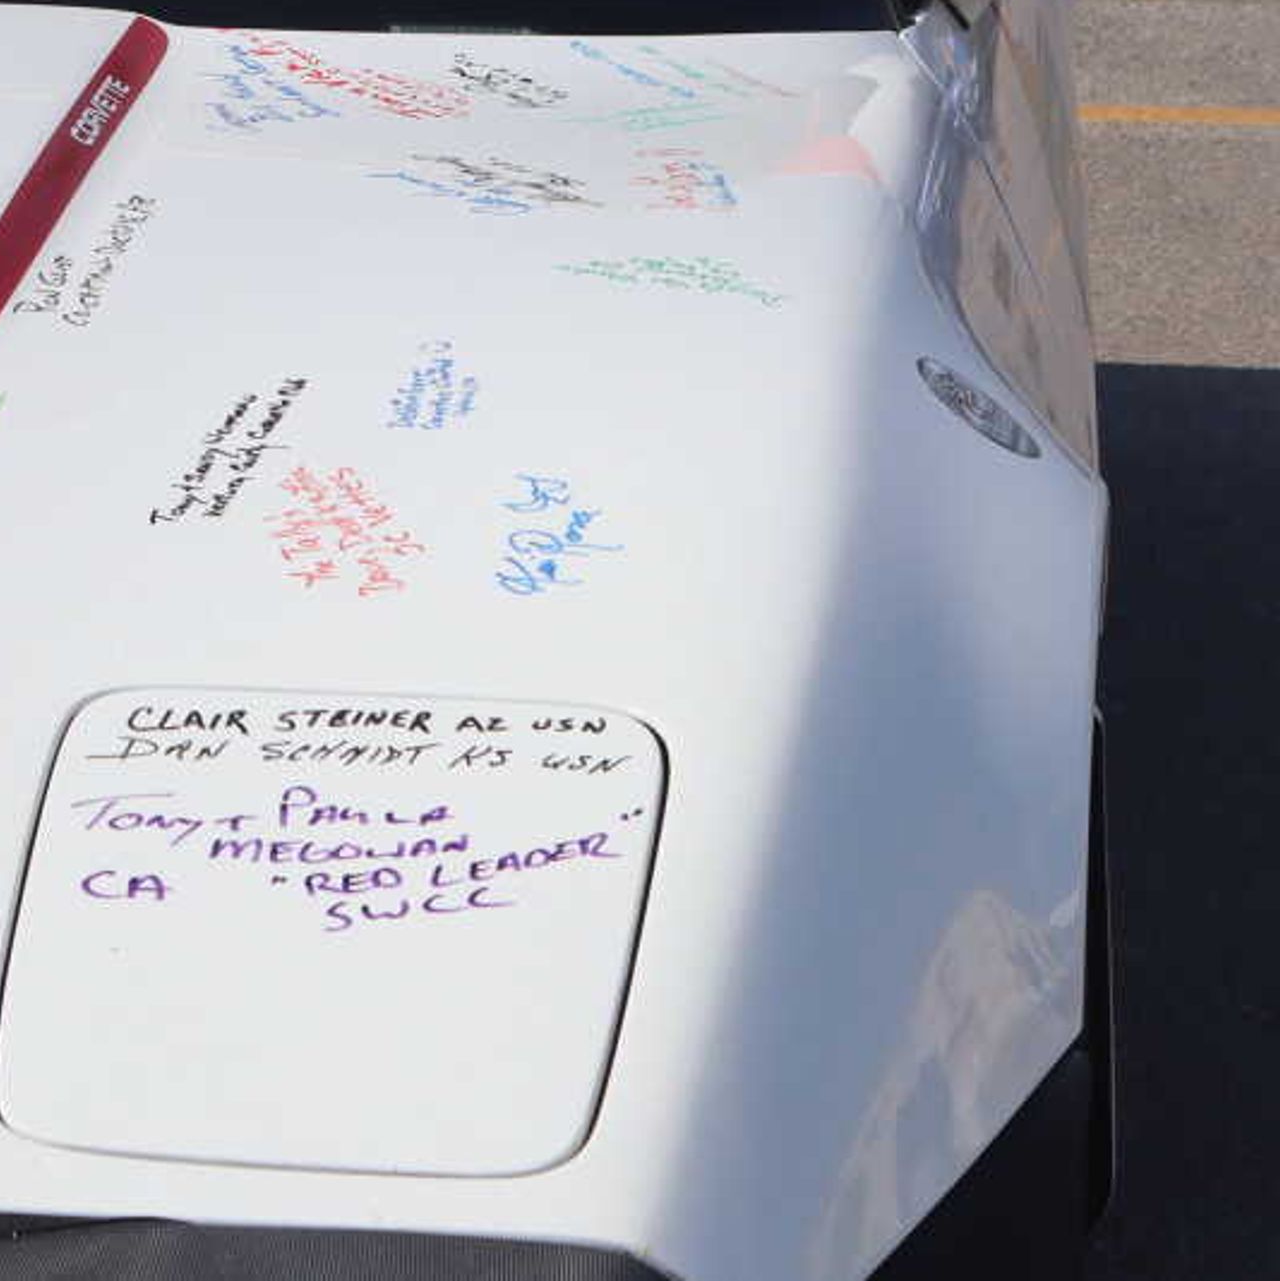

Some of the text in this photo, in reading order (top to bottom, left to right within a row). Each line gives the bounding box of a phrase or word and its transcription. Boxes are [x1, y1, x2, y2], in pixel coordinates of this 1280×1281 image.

[70, 76, 134, 147] CORVETTE
[127, 707, 606, 736] CLAIR STEINER AZ USN
[81, 870, 171, 901] CA
